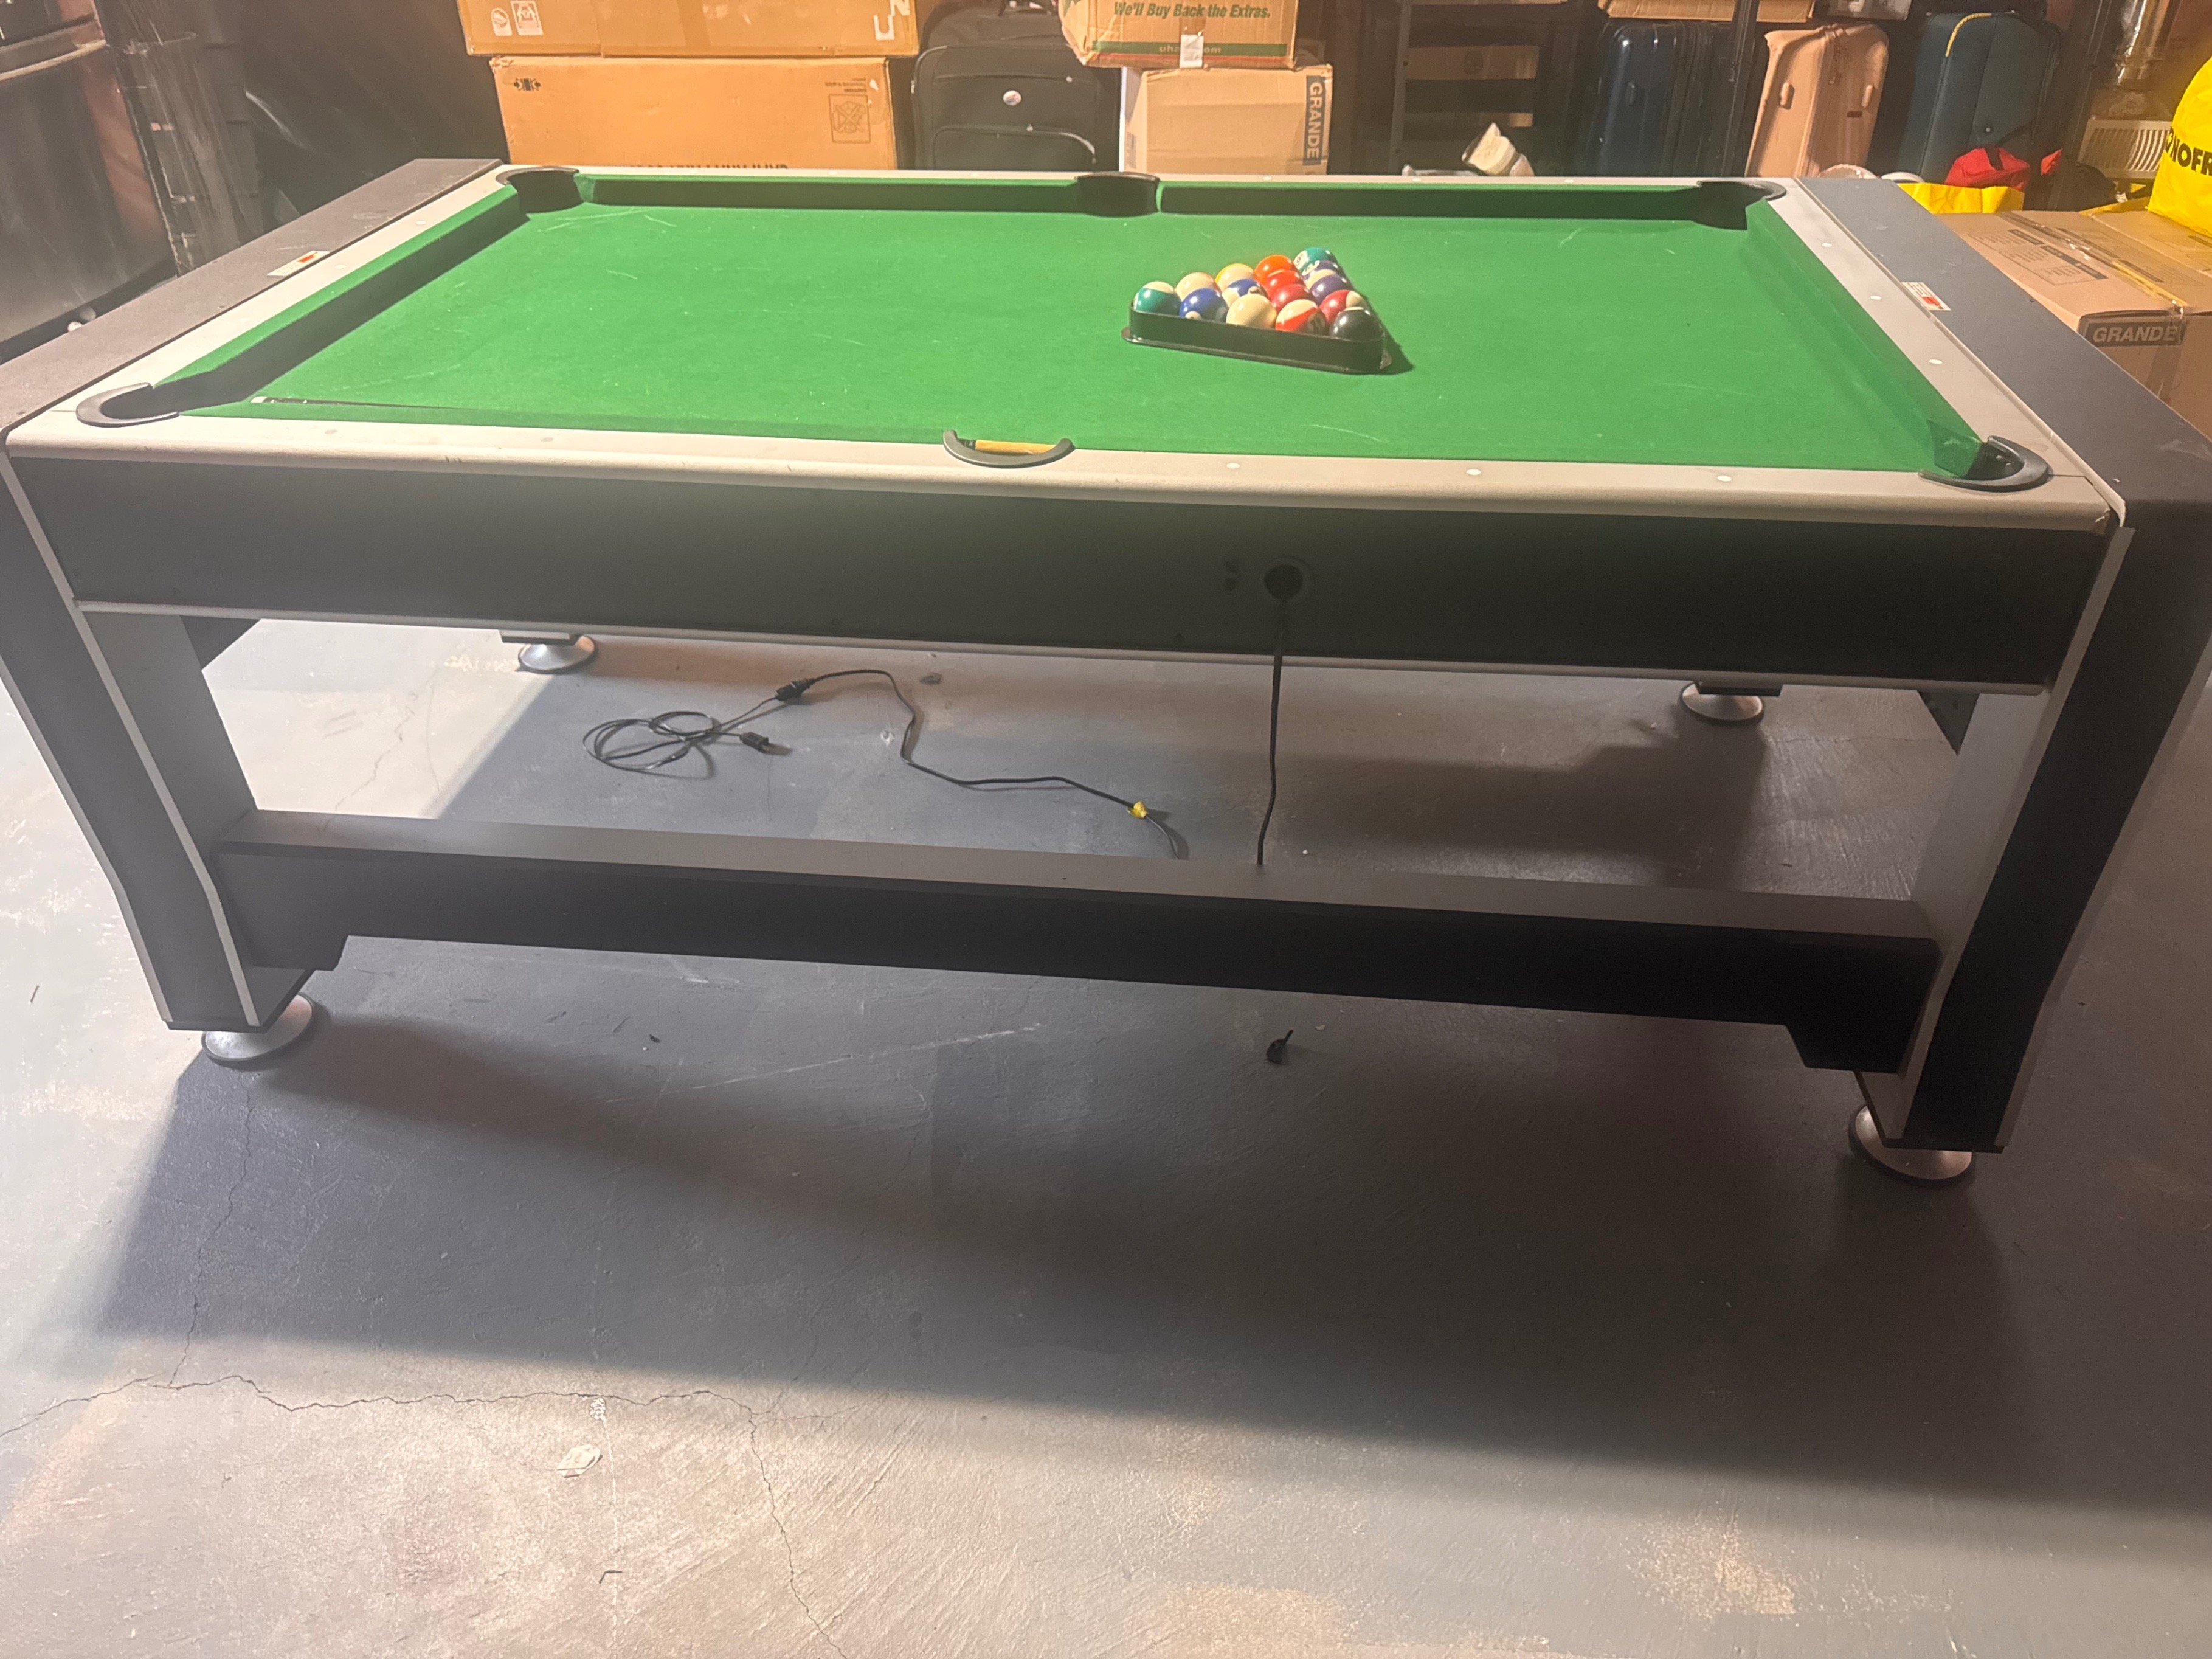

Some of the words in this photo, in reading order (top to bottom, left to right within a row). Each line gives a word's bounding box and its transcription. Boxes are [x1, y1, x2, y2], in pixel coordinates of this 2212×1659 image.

[1114, 2, 1144, 16] We'll
[1147, 3, 1171, 19] Buy
[1173, 3, 1206, 17] Back
[1208, 4, 1228, 18] the
[1229, 4, 1271, 18] Extras.
[1307, 82, 1323, 159] GRANDE
[2092, 325, 2178, 343] GRANDE
